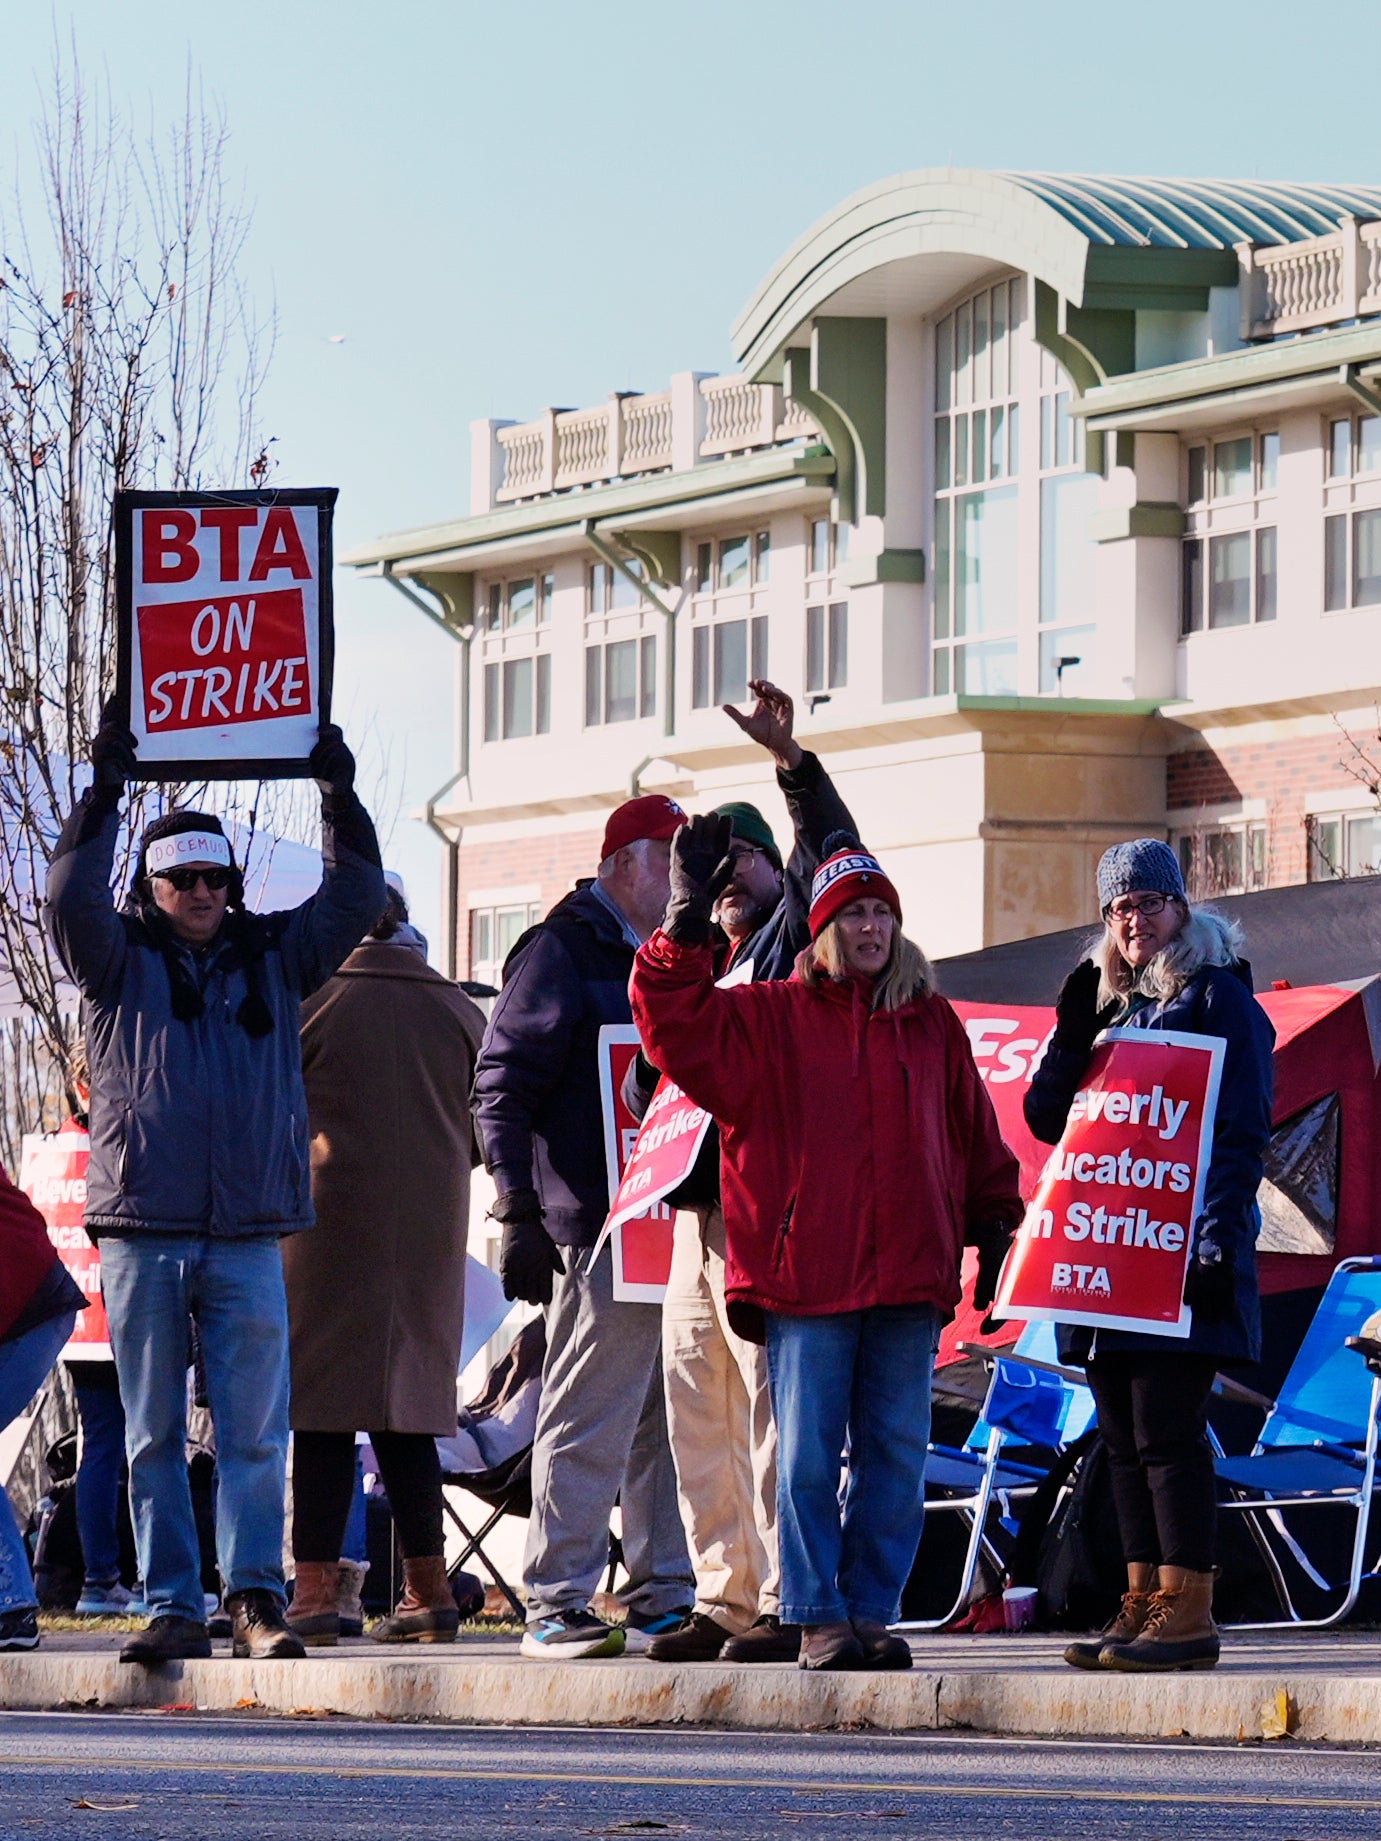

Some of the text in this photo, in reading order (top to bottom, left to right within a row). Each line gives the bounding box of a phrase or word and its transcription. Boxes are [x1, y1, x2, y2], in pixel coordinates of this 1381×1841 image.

[142, 507, 313, 584] BTA
[191, 600, 256, 656] ON
[149, 657, 305, 724] STRIKE
[633, 1107, 706, 1163] Strike
[1067, 1085, 1189, 1140] everly
[1044, 1148, 1191, 1193] ucators
[1064, 1202, 1184, 1252] Strike
[1051, 1262, 1111, 1291] BTA
